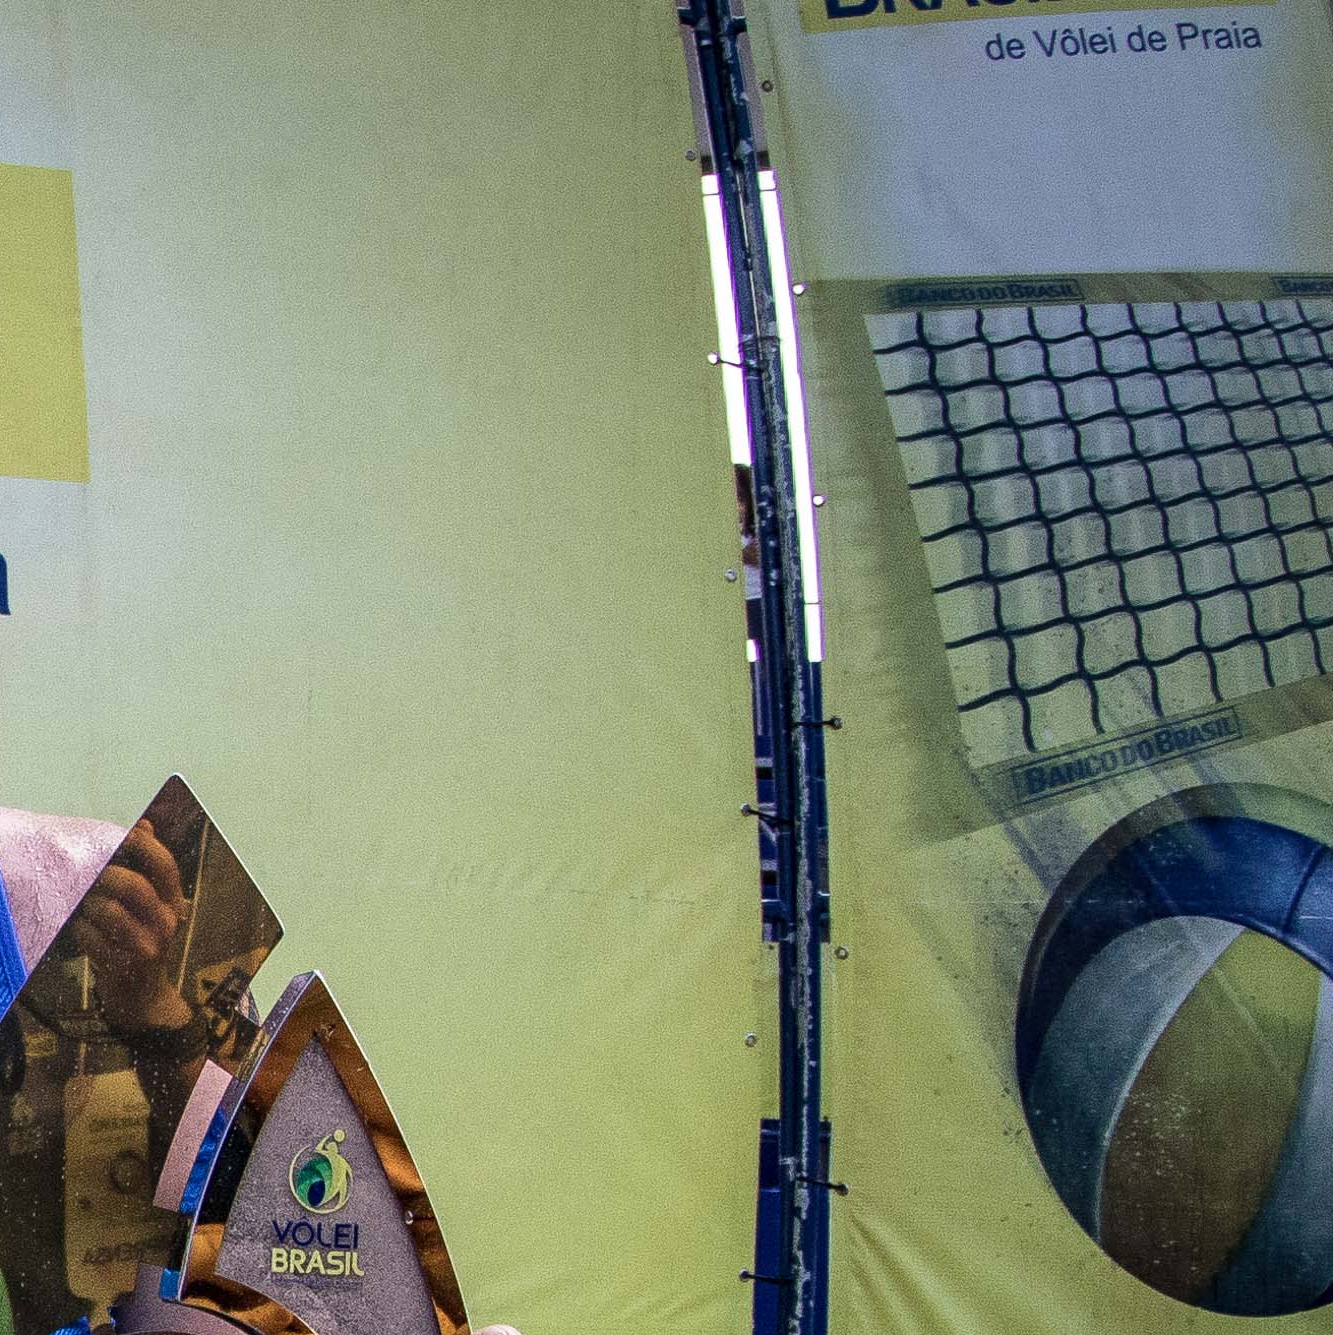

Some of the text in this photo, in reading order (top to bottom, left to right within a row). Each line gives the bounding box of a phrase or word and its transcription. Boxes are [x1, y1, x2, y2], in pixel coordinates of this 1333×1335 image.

[985, 21, 1263, 61] de Vôlei de Praia
[1154, 716, 1235, 754] BRASIL
[272, 1217, 359, 1249] VÔLEI
[271, 1248, 364, 1276] BRASIL
